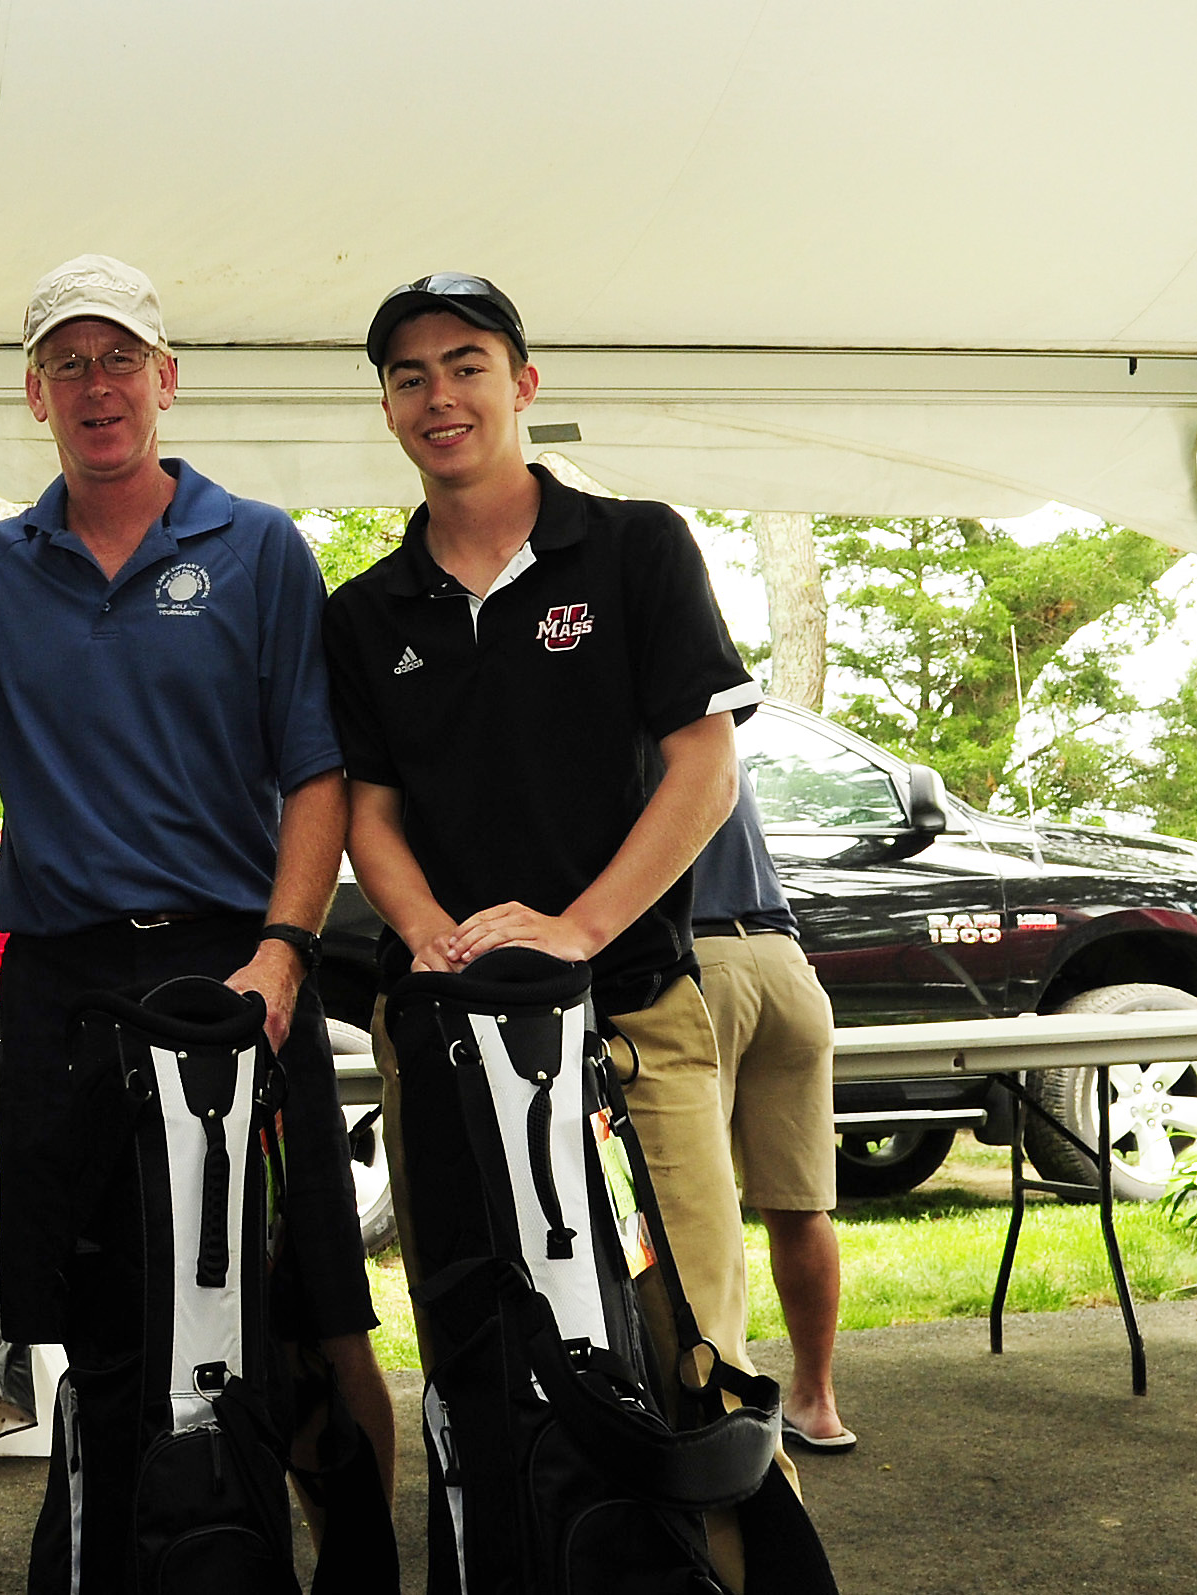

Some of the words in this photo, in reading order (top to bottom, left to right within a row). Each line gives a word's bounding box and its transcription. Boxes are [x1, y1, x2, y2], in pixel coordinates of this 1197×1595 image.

[47, 269, 139, 305] Titleist
[158, 609, 201, 617] TOURNAMENT
[393, 658, 424, 675] adidas
[926, 914, 1001, 929] RAM
[928, 928, 1002, 944] 1500
